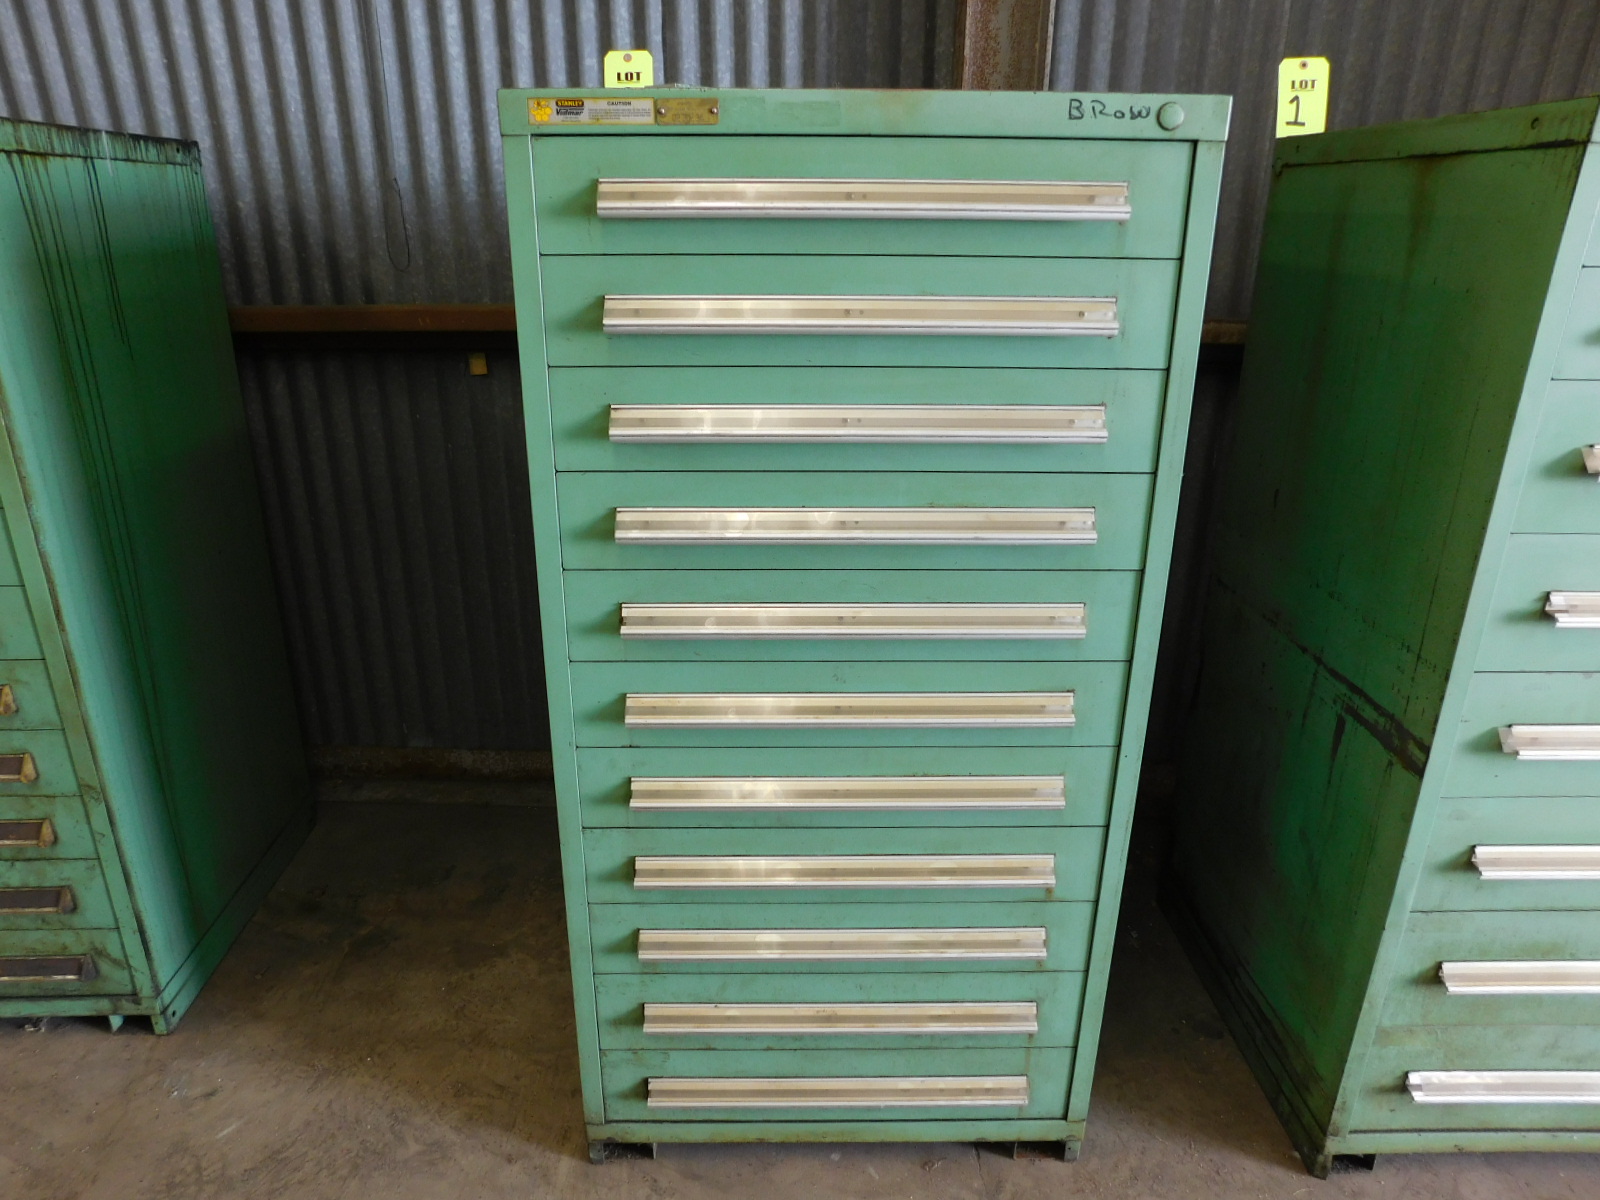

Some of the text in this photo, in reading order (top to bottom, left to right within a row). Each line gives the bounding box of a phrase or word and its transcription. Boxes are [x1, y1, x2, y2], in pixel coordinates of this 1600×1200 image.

[616, 72, 642, 82] LOT
[1291, 80, 1316, 90] LOT
[556, 108, 584, 116] Vidmar
[1286, 95, 1306, 127] 1
